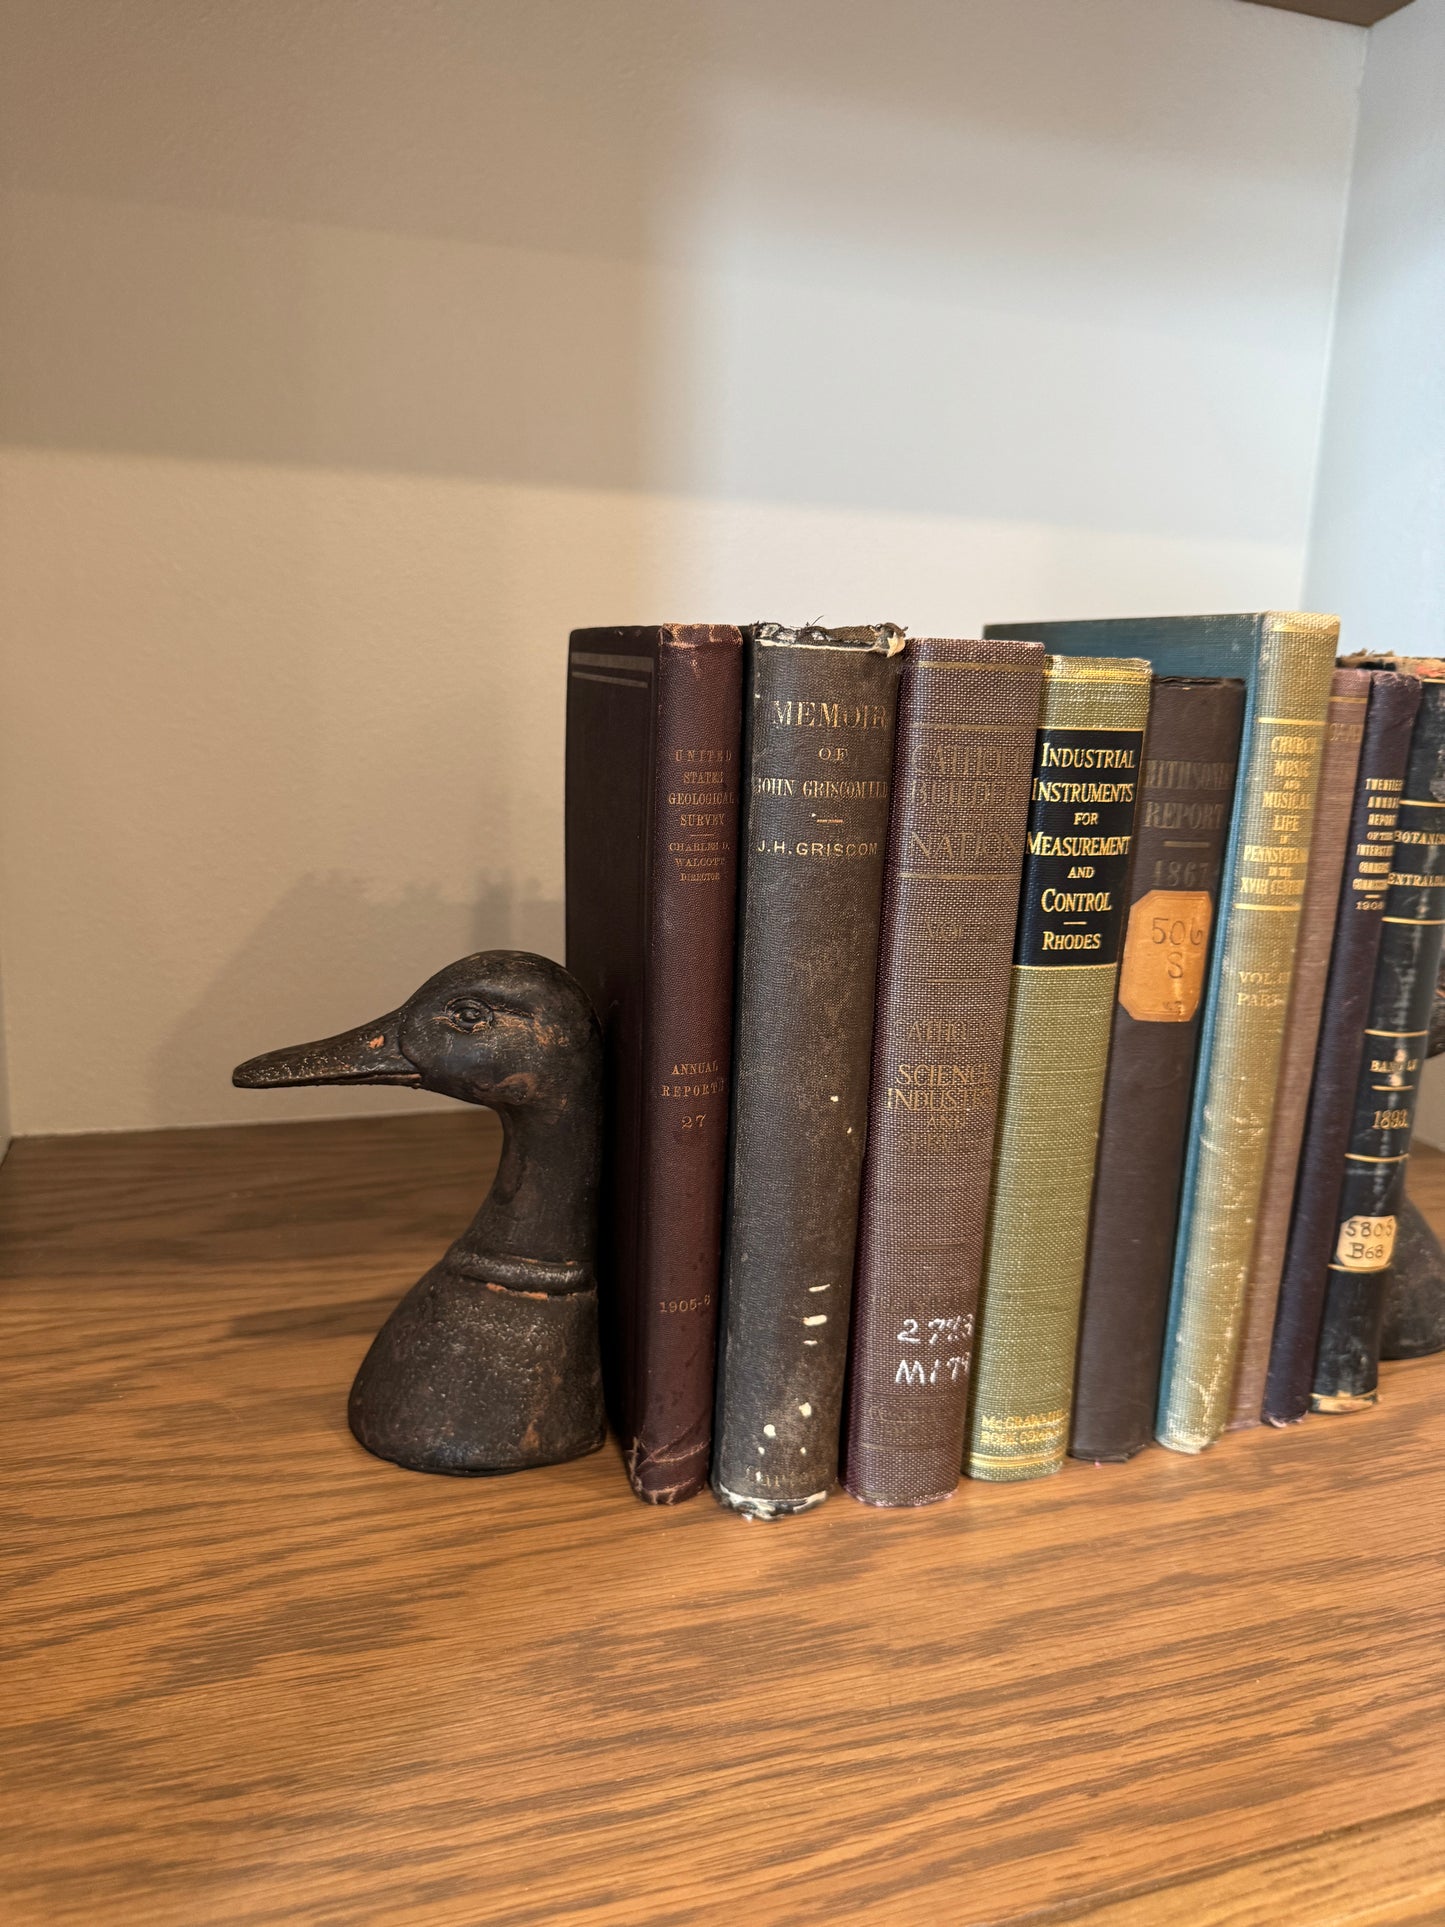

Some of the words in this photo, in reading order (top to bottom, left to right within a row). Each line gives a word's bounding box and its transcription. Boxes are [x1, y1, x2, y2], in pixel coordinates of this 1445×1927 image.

[771, 699, 888, 729] MEMOIR
[675, 749, 732, 762] UNITED
[818, 747, 848, 761] OF
[1041, 742, 1135, 769] INDUSTRIAL
[1031, 777, 1134, 803] INSTRUMENTS
[668, 792, 734, 805] GEOLOGICAL
[680, 814, 725, 826] SURVEY
[1073, 812, 1098, 826] FOR
[1143, 800, 1225, 830] REPORT
[1272, 815, 1300, 831] LIFE
[669, 842, 719, 852] CHARLES
[1025, 831, 1132, 857] MEASUREMENT
[1067, 866, 1095, 879] AND
[1041, 888, 1113, 914] CONTROL
[1042, 930, 1102, 951] RHODES
[671, 1060, 719, 1076] ANNUAL
[895, 1063, 992, 1087] SCIENCE
[681, 1113, 707, 1129] 27
